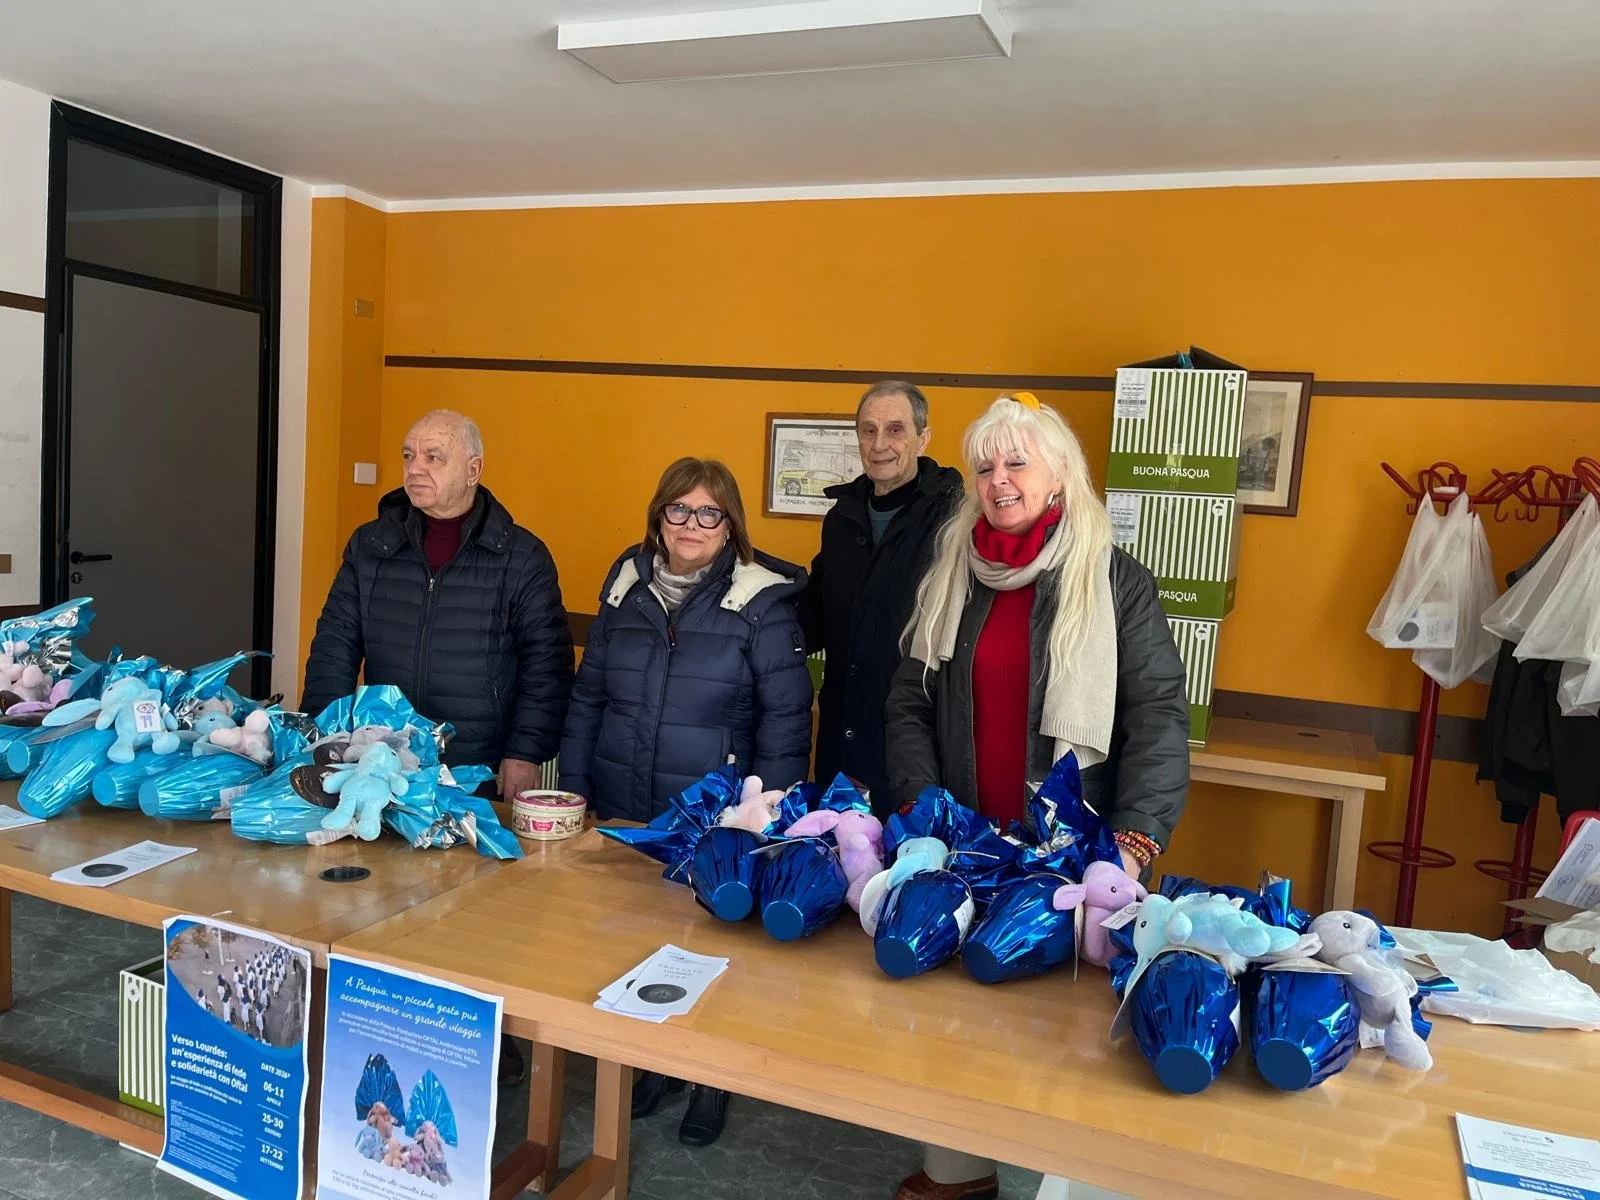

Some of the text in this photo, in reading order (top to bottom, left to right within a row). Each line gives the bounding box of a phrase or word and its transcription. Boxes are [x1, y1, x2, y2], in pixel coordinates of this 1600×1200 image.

[1133, 466, 1210, 480] BUONA PASQUA
[1158, 590, 1198, 602] PASQUA
[345, 976, 353, 986] A
[392, 992, 403, 1001] un
[404, 996, 434, 1009] piccolo
[436, 1004, 459, 1016] gesto
[461, 1011, 478, 1022] può
[340, 993, 482, 1039] accompagnare un grande viaggio
[171, 1034, 228, 1058] Verso Lourdes:
[171, 1047, 247, 1080] un'esperienza di fede
[261, 1062, 275, 1074] DATE
[178, 1061, 217, 1080] solidarietà
[218, 1074, 230, 1086] con
[231, 1079, 248, 1093] Oftal
[263, 1081, 284, 1098] 06-11
[262, 1113, 284, 1129] 25-30
[261, 1144, 283, 1161] 17-22
